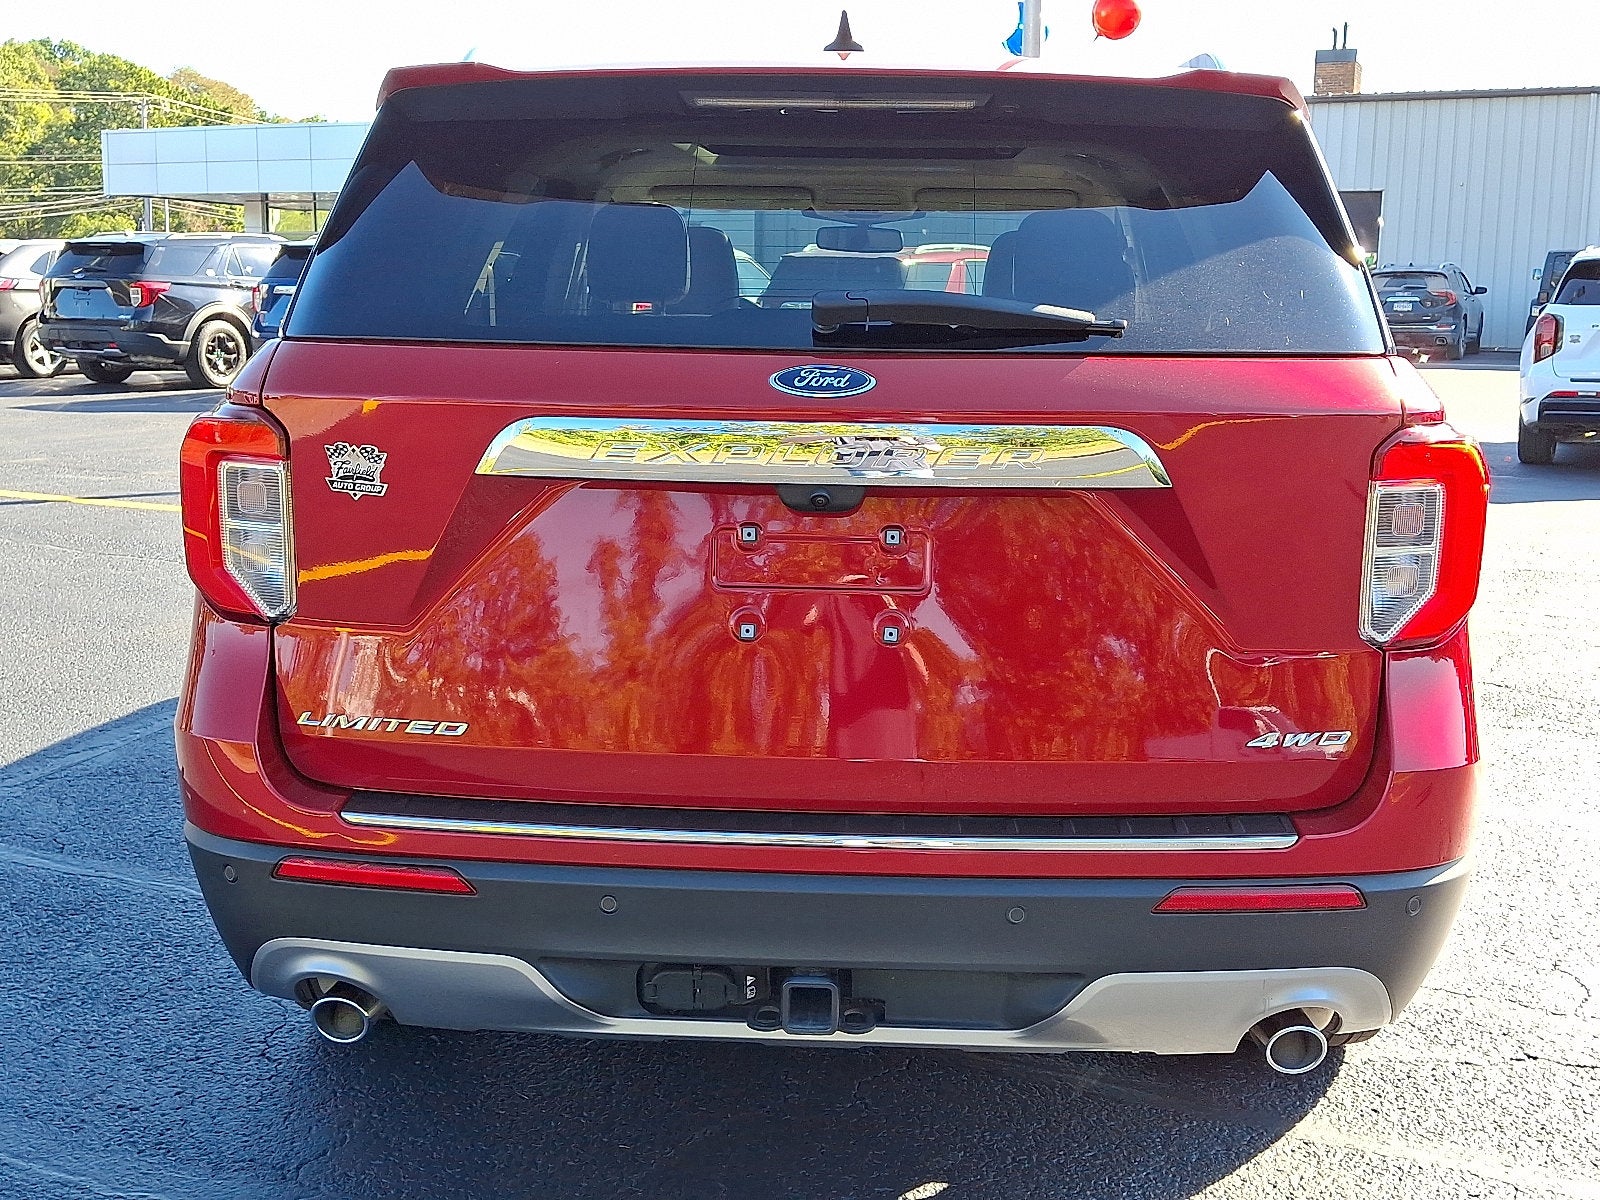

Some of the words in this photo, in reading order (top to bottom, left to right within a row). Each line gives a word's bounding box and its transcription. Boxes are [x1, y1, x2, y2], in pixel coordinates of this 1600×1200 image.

[793, 368, 851, 388] Ford
[588, 440, 1045, 470] EXPLORER
[332, 481, 353, 491] AUTO
[355, 484, 382, 493] GROUP
[297, 711, 469, 737] LIMITED
[1245, 731, 1352, 748] 4WD
